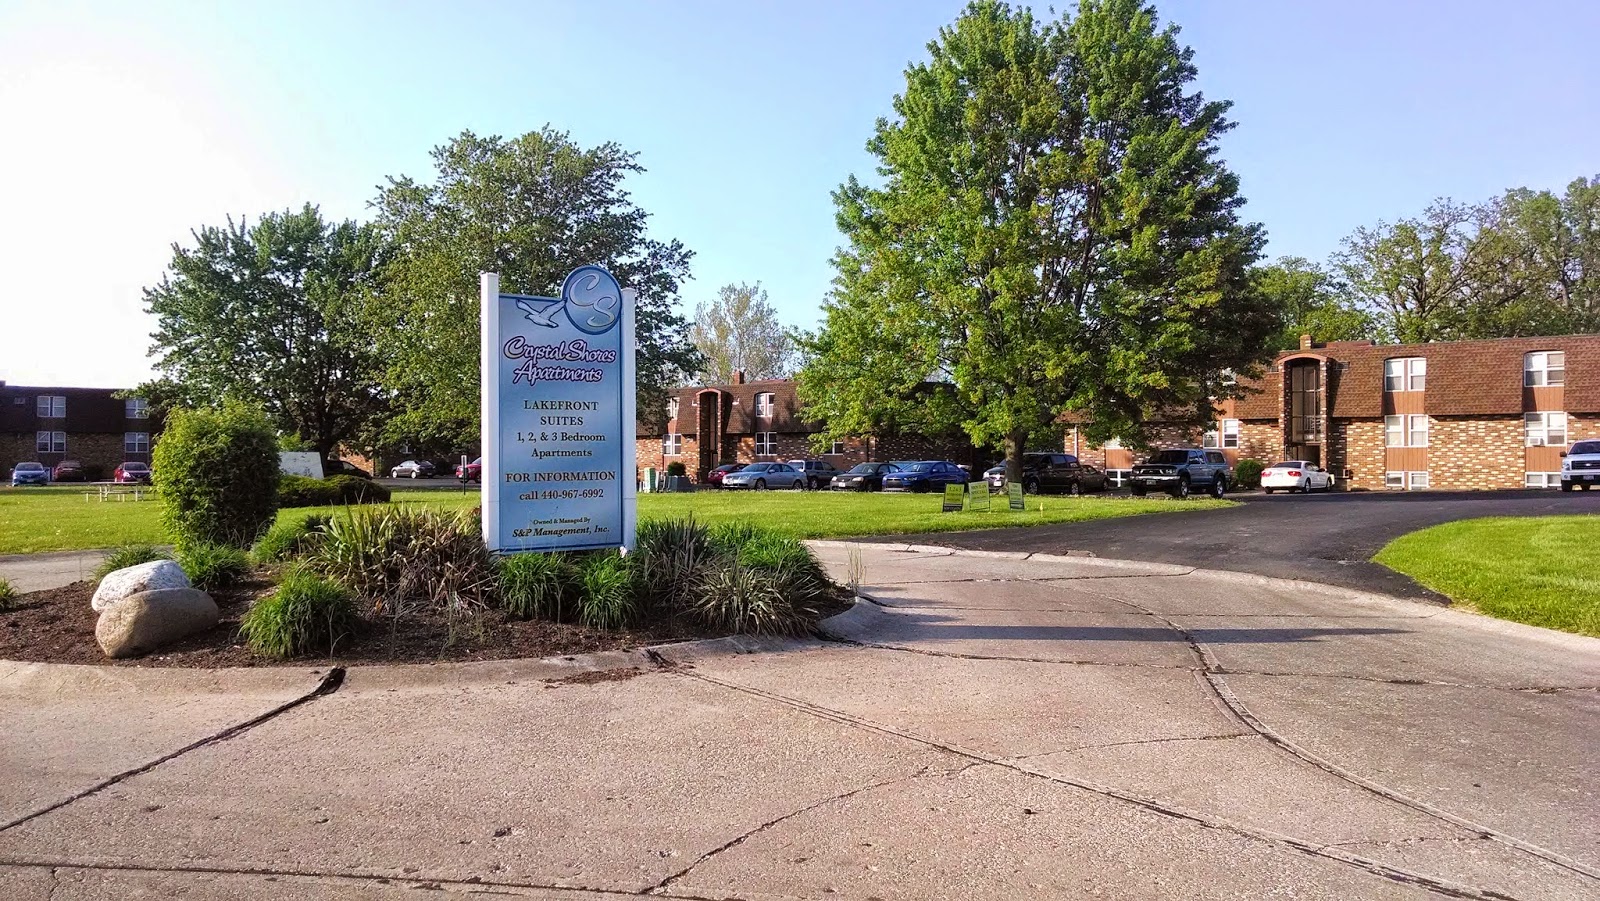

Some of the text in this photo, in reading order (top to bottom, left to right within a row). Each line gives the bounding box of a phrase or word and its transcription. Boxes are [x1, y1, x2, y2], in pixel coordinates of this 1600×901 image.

[503, 336, 616, 364] Crystal Shores
[513, 360, 603, 386] Apartments
[523, 400, 599, 411] LAKEFRONT
[540, 416, 584, 426] SUITES
[540, 432, 549, 442] &
[551, 432, 558, 442] 3
[560, 432, 606, 442] Bedroom
[531, 448, 593, 459] Apartments
[506, 471, 616, 483] FOR INFORMATION
[519, 489, 604, 501] call 440-967-6992
[512, 525, 610, 538] S&P Management, Inc.
